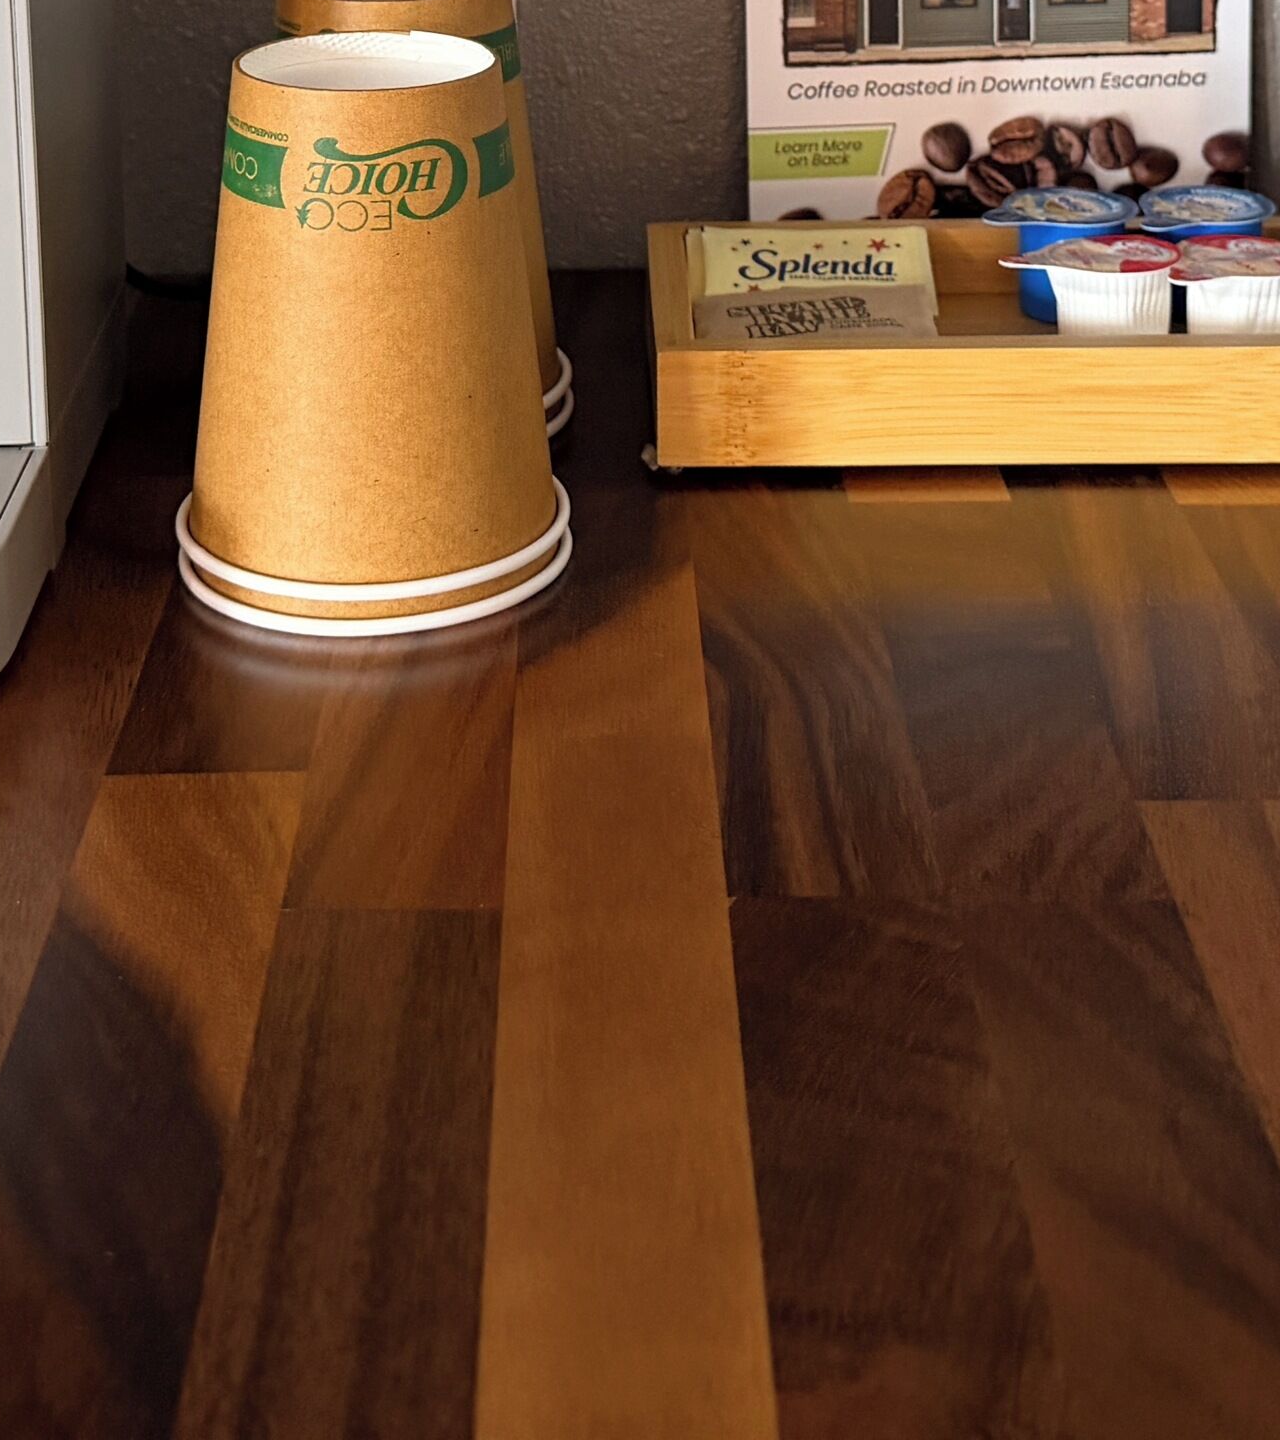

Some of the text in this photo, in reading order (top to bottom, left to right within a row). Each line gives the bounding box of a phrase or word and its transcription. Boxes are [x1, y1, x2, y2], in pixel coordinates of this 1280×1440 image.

[787, 70, 1207, 101] Coffee Roasted in Downtown Escanaba
[774, 138, 863, 155] Learn More
[787, 152, 849, 167] on Back
[302, 137, 468, 220] CHOICE
[297, 196, 393, 232] ECO
[738, 248, 894, 282] Splenda
